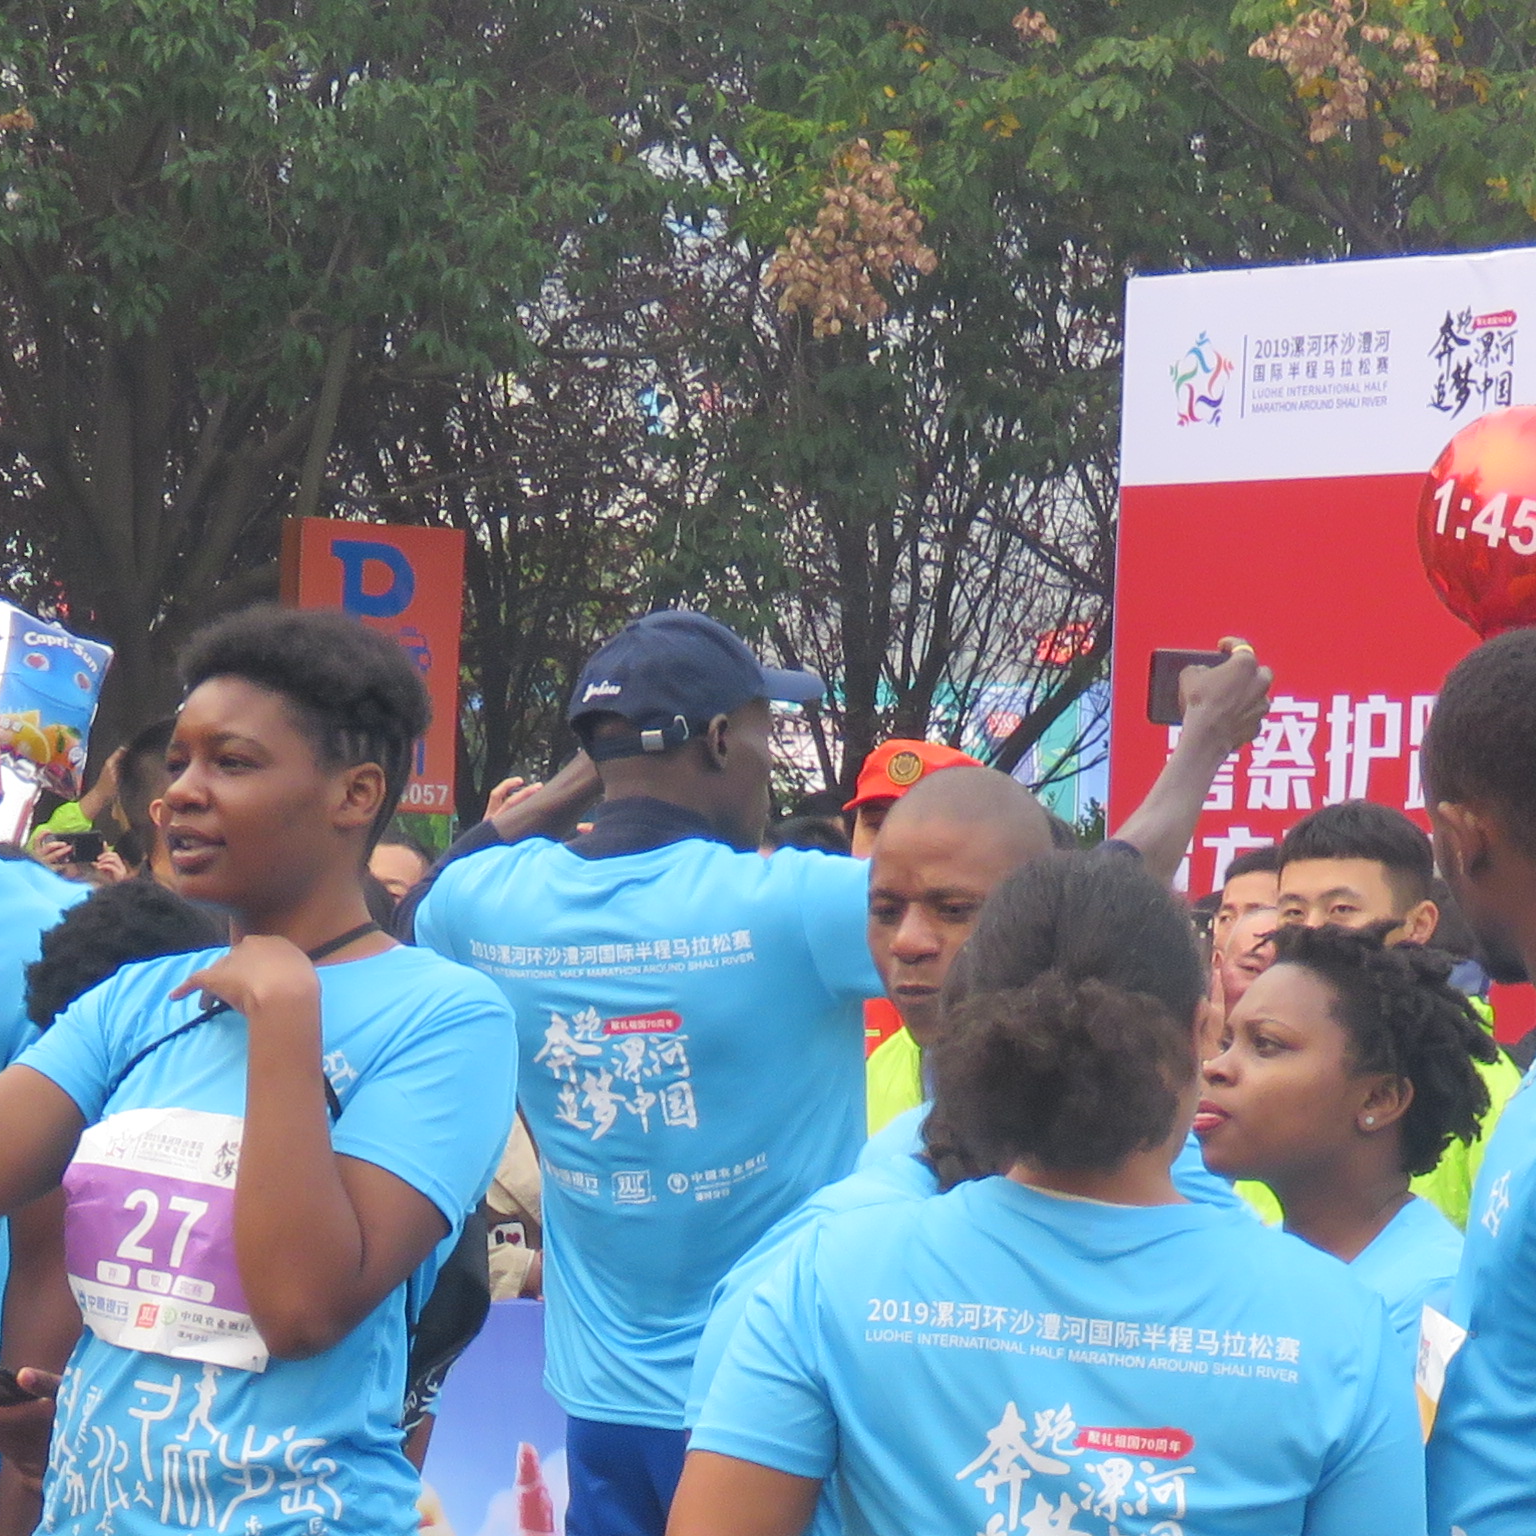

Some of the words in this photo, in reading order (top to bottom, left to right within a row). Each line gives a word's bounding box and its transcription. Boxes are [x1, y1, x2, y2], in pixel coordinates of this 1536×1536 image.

[1254, 330, 1391, 359] 2019漯河环沙澧河
[1253, 355, 1390, 383] 国际半程马拉松赛
[1251, 399, 1298, 414] MARATHON
[1298, 399, 1334, 411] AROUND
[1335, 397, 1360, 410] SHALI
[1361, 395, 1388, 408] RIVER
[1252, 385, 1283, 400] LUOHE
[1286, 382, 1361, 397] INTERNATIONAL
[1365, 380, 1388, 393] HALF
[330, 539, 415, 618] P
[24, 631, 98, 673] Capri-Sun
[722, 952, 755, 968] RIVER
[116, 1188, 209, 1269] 27
[867, 1298, 1301, 1365] 2019漯河环沙澧河国际半程马拉松赛
[866, 1329, 913, 1344] LUOHE
[917, 1332, 1026, 1356] INTERNATIONAL
[1030, 1344, 1064, 1360] HALF
[1068, 1350, 1146, 1369] MARATHON
[1147, 1356, 1209, 1376] AROUND
[1212, 1362, 1253, 1379] SHALI
[1255, 1365, 1299, 1384] RIVER
[1087, 1430, 1182, 1454] 献礼祖国70周年
